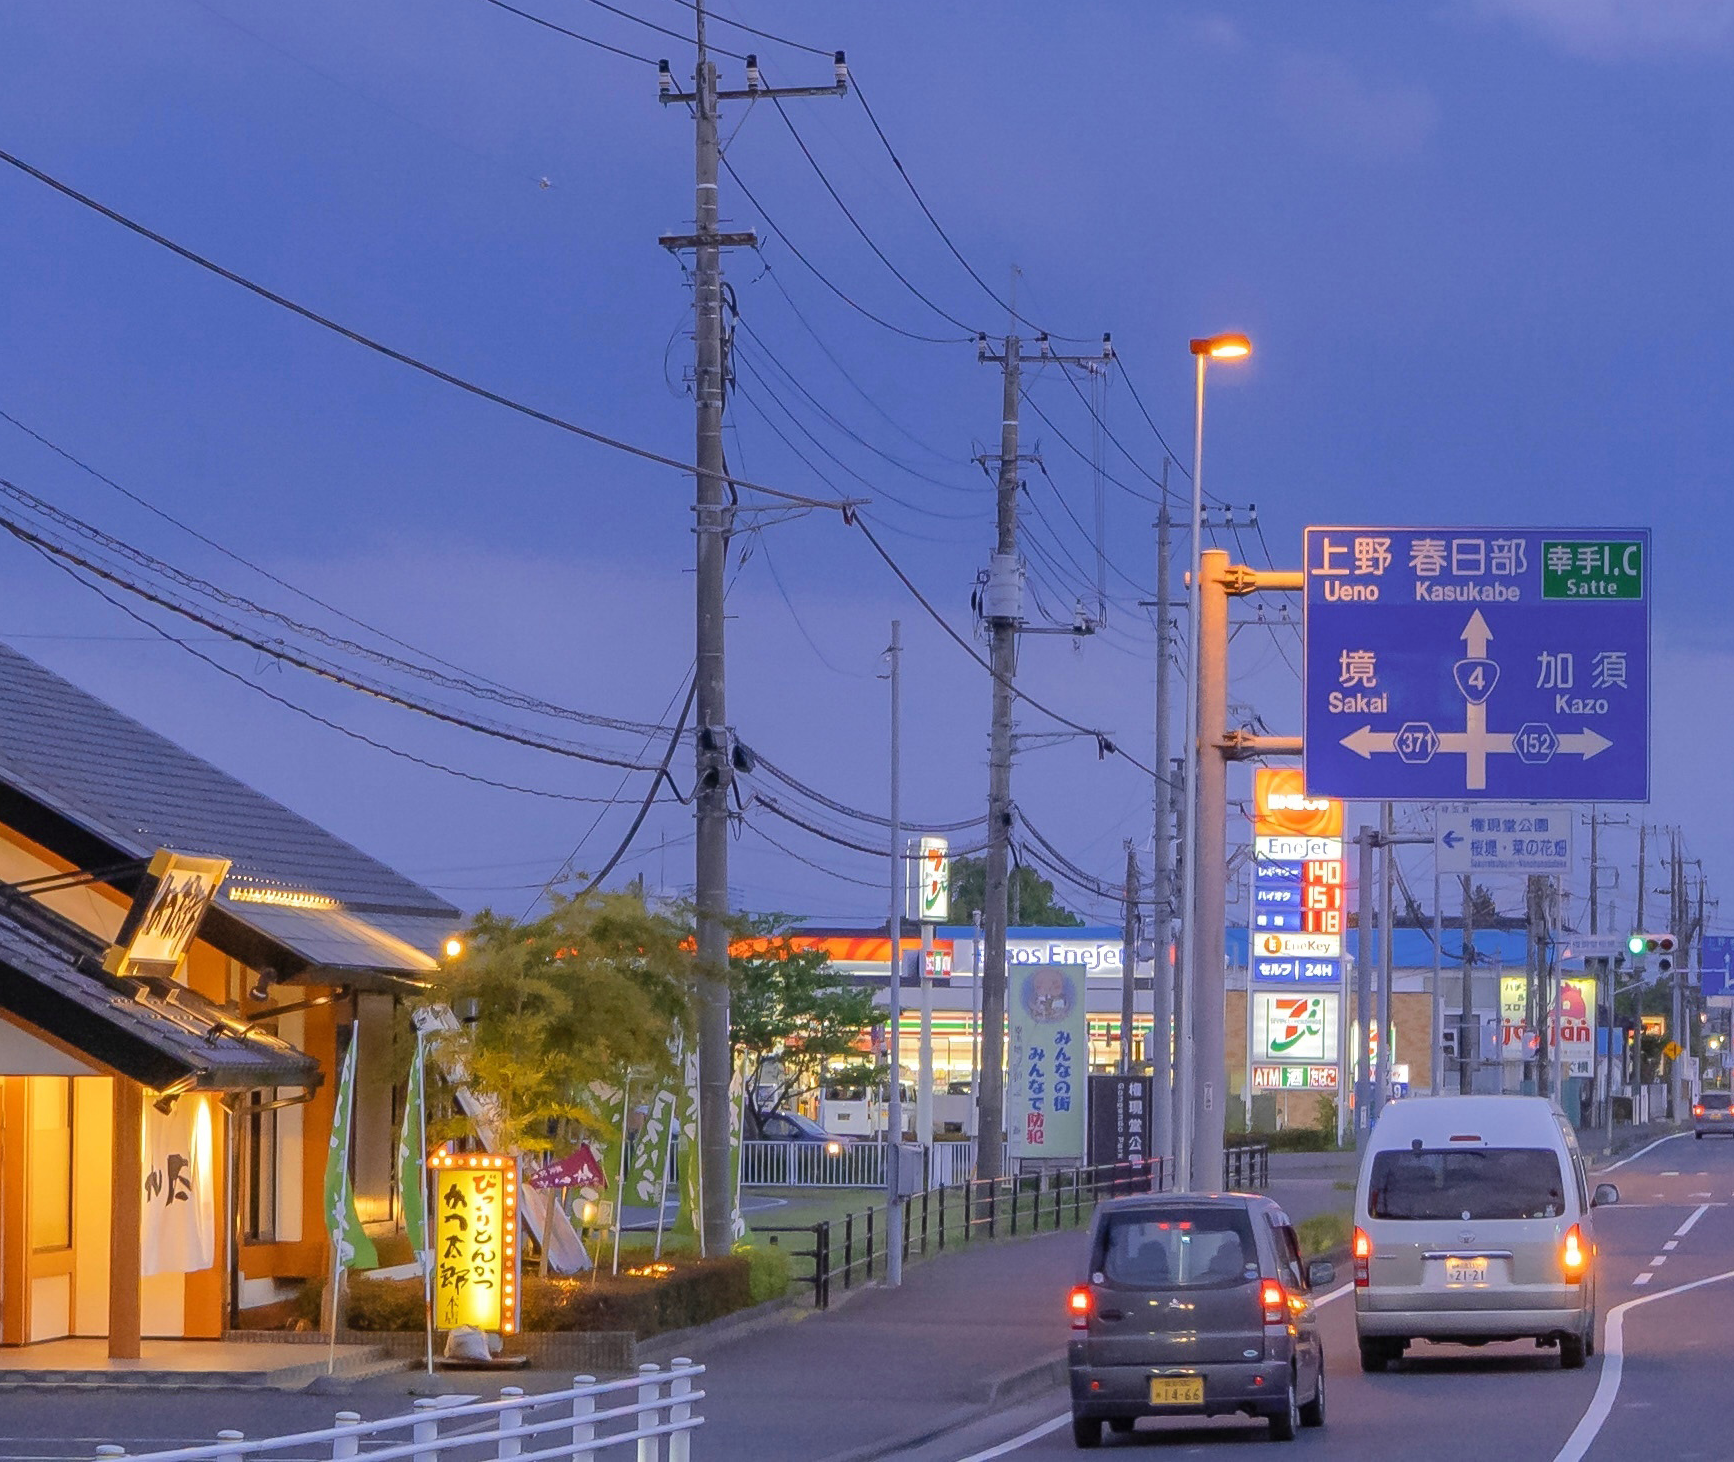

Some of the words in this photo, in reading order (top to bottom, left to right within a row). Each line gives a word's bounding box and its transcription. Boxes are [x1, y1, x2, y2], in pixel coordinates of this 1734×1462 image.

[1311, 537, 1393, 576] 上野
[1409, 538, 1528, 577] 春日部
[1547, 545, 1638, 577] 幸手I.C
[1324, 581, 1379, 601] Ueno
[1416, 581, 1520, 602] Kasukabe
[1566, 579, 1618, 595] Satte
[1338, 649, 1377, 688] 境
[1468, 667, 1486, 691] 4
[1536, 651, 1628, 689] 加須
[1328, 692, 1388, 714] Sakai
[1555, 694, 1609, 714] Kazo
[1402, 732, 1433, 753] 371
[1521, 733, 1551, 754] 152
[1470, 817, 1549, 832] 権現堂公園
[1268, 838, 1329, 859] EneJet
[1308, 861, 1341, 884] 140
[1258, 891, 1292, 902] ハイオク
[1308, 886, 1341, 909] 151
[1308, 911, 1340, 933] 118
[1258, 963, 1292, 976] セルフ
[1304, 964, 1333, 977] 24H
[1054, 1030, 1072, 1112] みんなの街
[1254, 1068, 1280, 1087] ATM
[1286, 1067, 1303, 1087] 酒
[1310, 1067, 1337, 1086] たばこ
